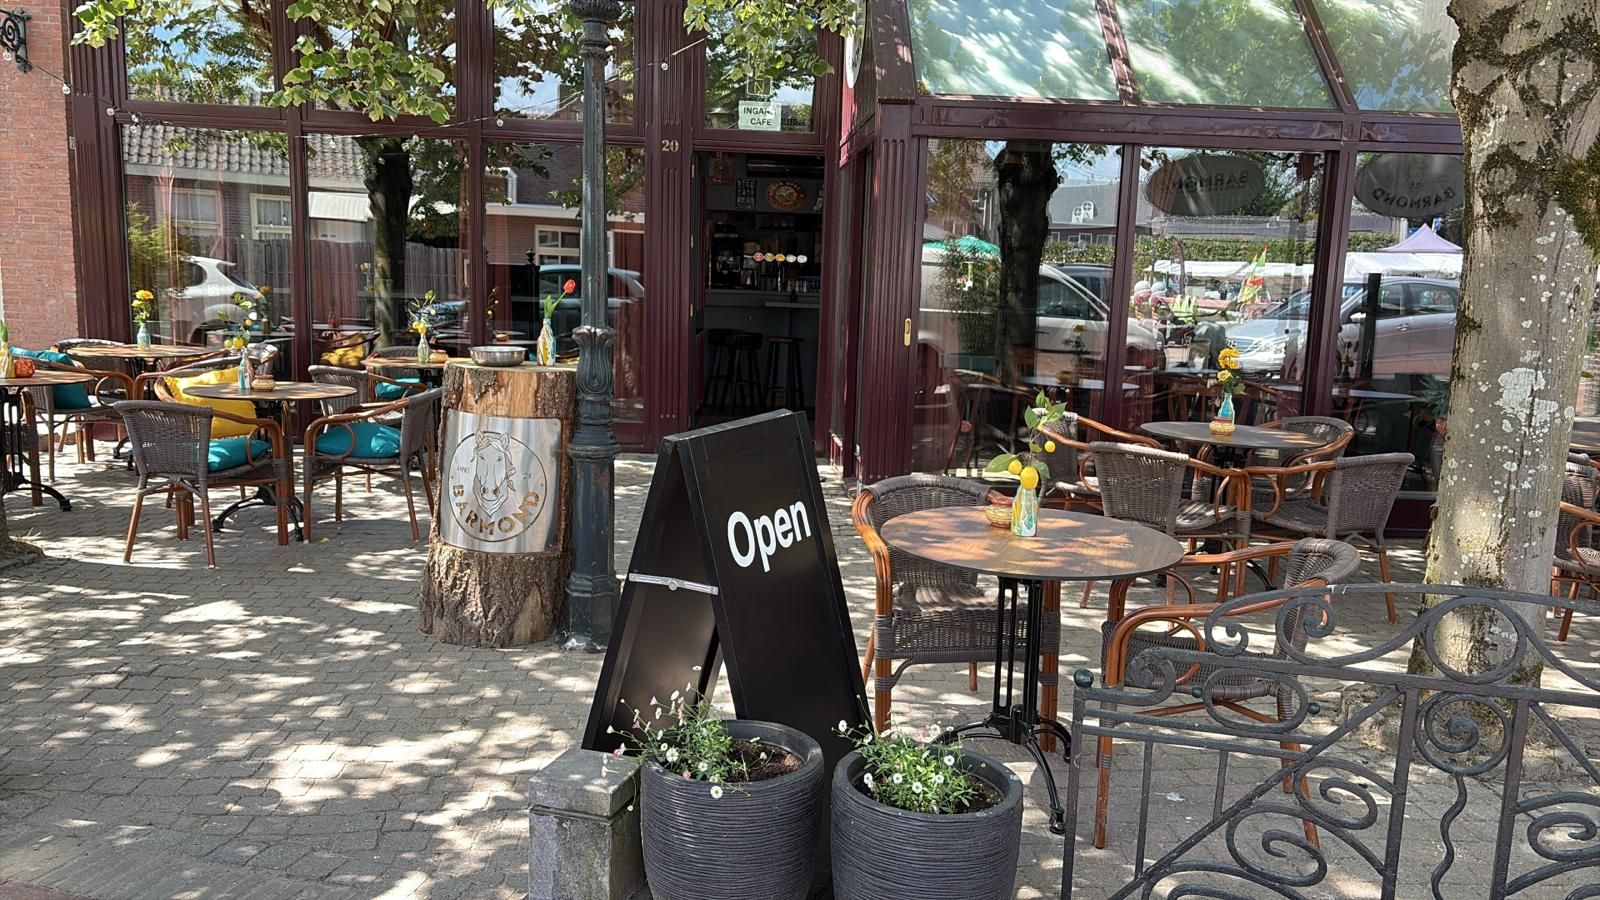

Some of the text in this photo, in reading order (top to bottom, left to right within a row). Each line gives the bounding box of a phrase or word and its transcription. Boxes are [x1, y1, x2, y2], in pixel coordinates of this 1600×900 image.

[743, 106, 777, 116] INGAN
[750, 117, 772, 126] CAFE
[661, 139, 679, 152] 20
[452, 484, 540, 536] BARMOND
[727, 501, 812, 573] Open
